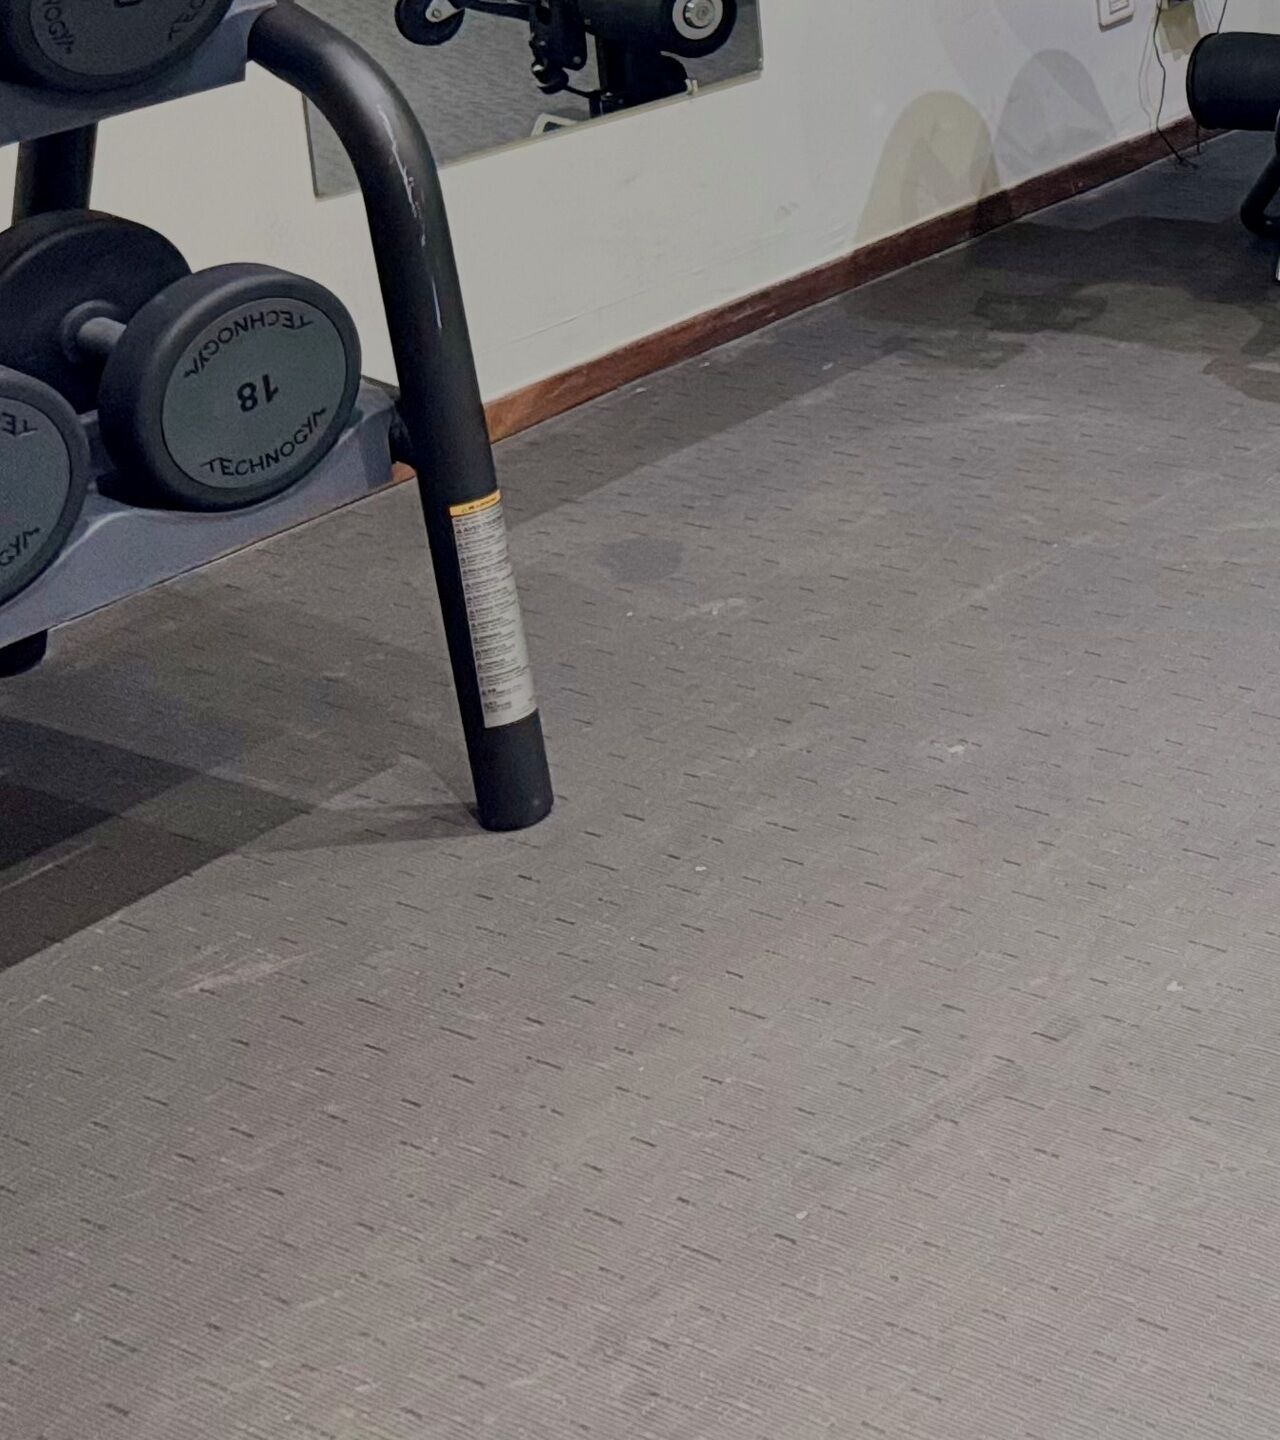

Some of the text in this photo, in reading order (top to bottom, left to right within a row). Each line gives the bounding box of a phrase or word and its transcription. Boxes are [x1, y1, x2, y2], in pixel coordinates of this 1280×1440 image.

[184, 309, 315, 378] TECHNOGYM
[235, 372, 280, 414] 18
[200, 406, 328, 476] TECHNOGYM
